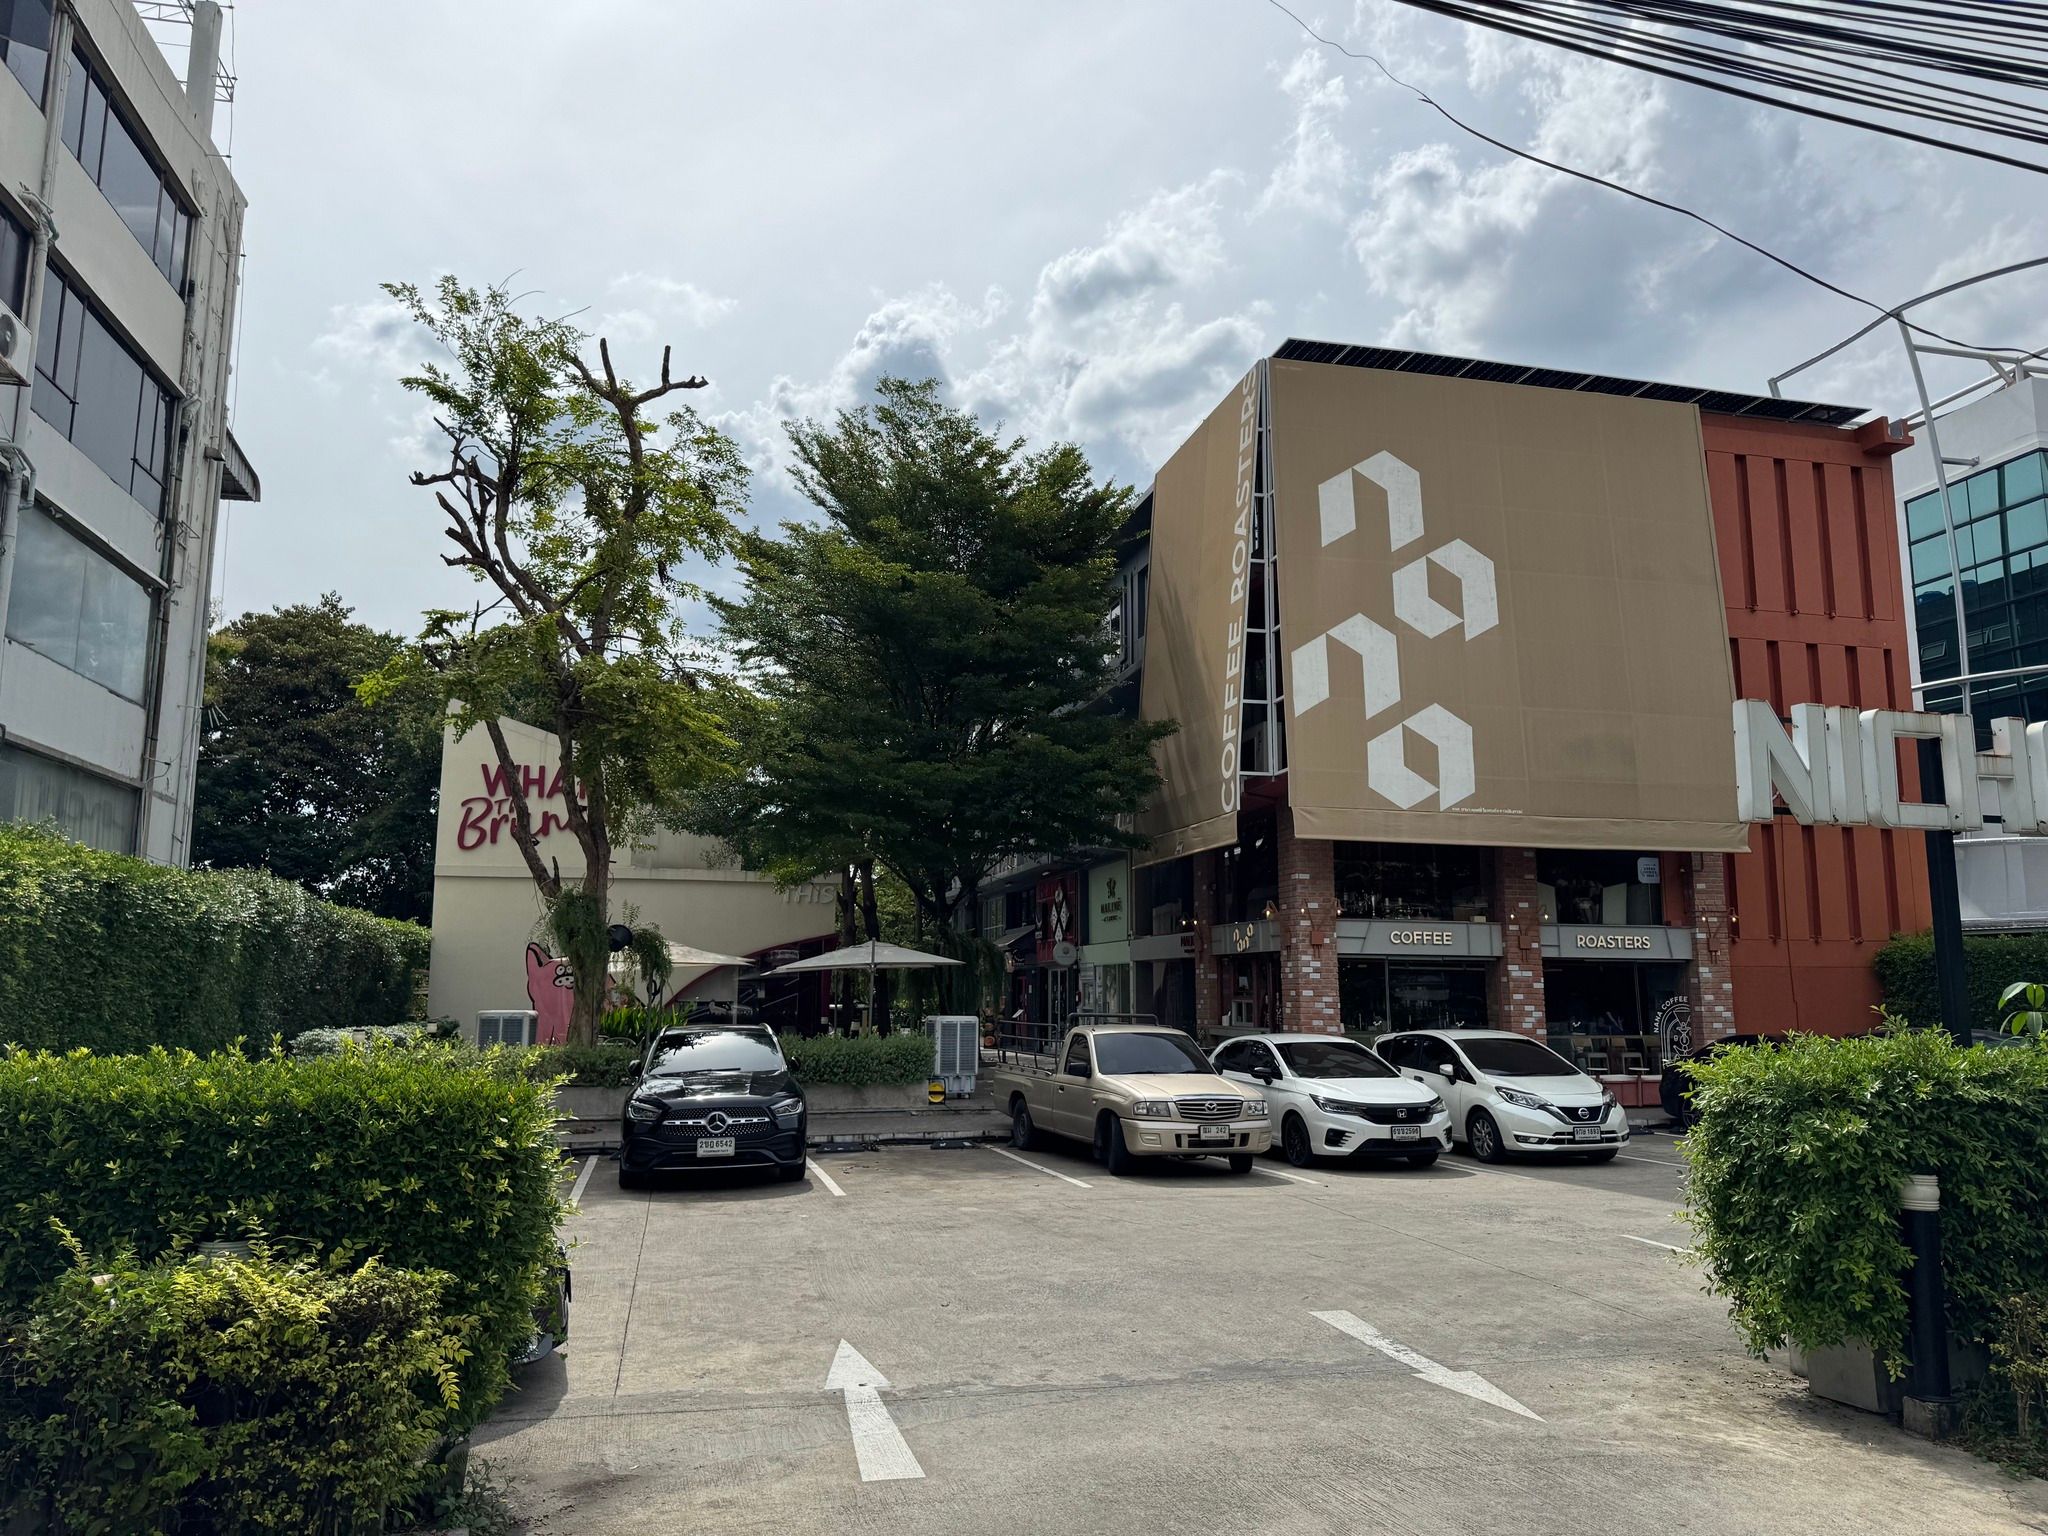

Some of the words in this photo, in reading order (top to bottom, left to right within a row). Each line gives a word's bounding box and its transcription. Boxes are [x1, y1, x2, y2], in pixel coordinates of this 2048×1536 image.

[1230, 367, 1257, 605] ROASTERS
[1221, 615, 1243, 813] COFFEE
[1732, 698, 2048, 835] NICH
[1390, 930, 1453, 946] COFFEE
[1576, 933, 1652, 951] ROASTERS
[1653, 1011, 1663, 1034] NANA
[1661, 995, 1689, 1010] COFFEE
[1215, 1126, 1227, 1134] 242
